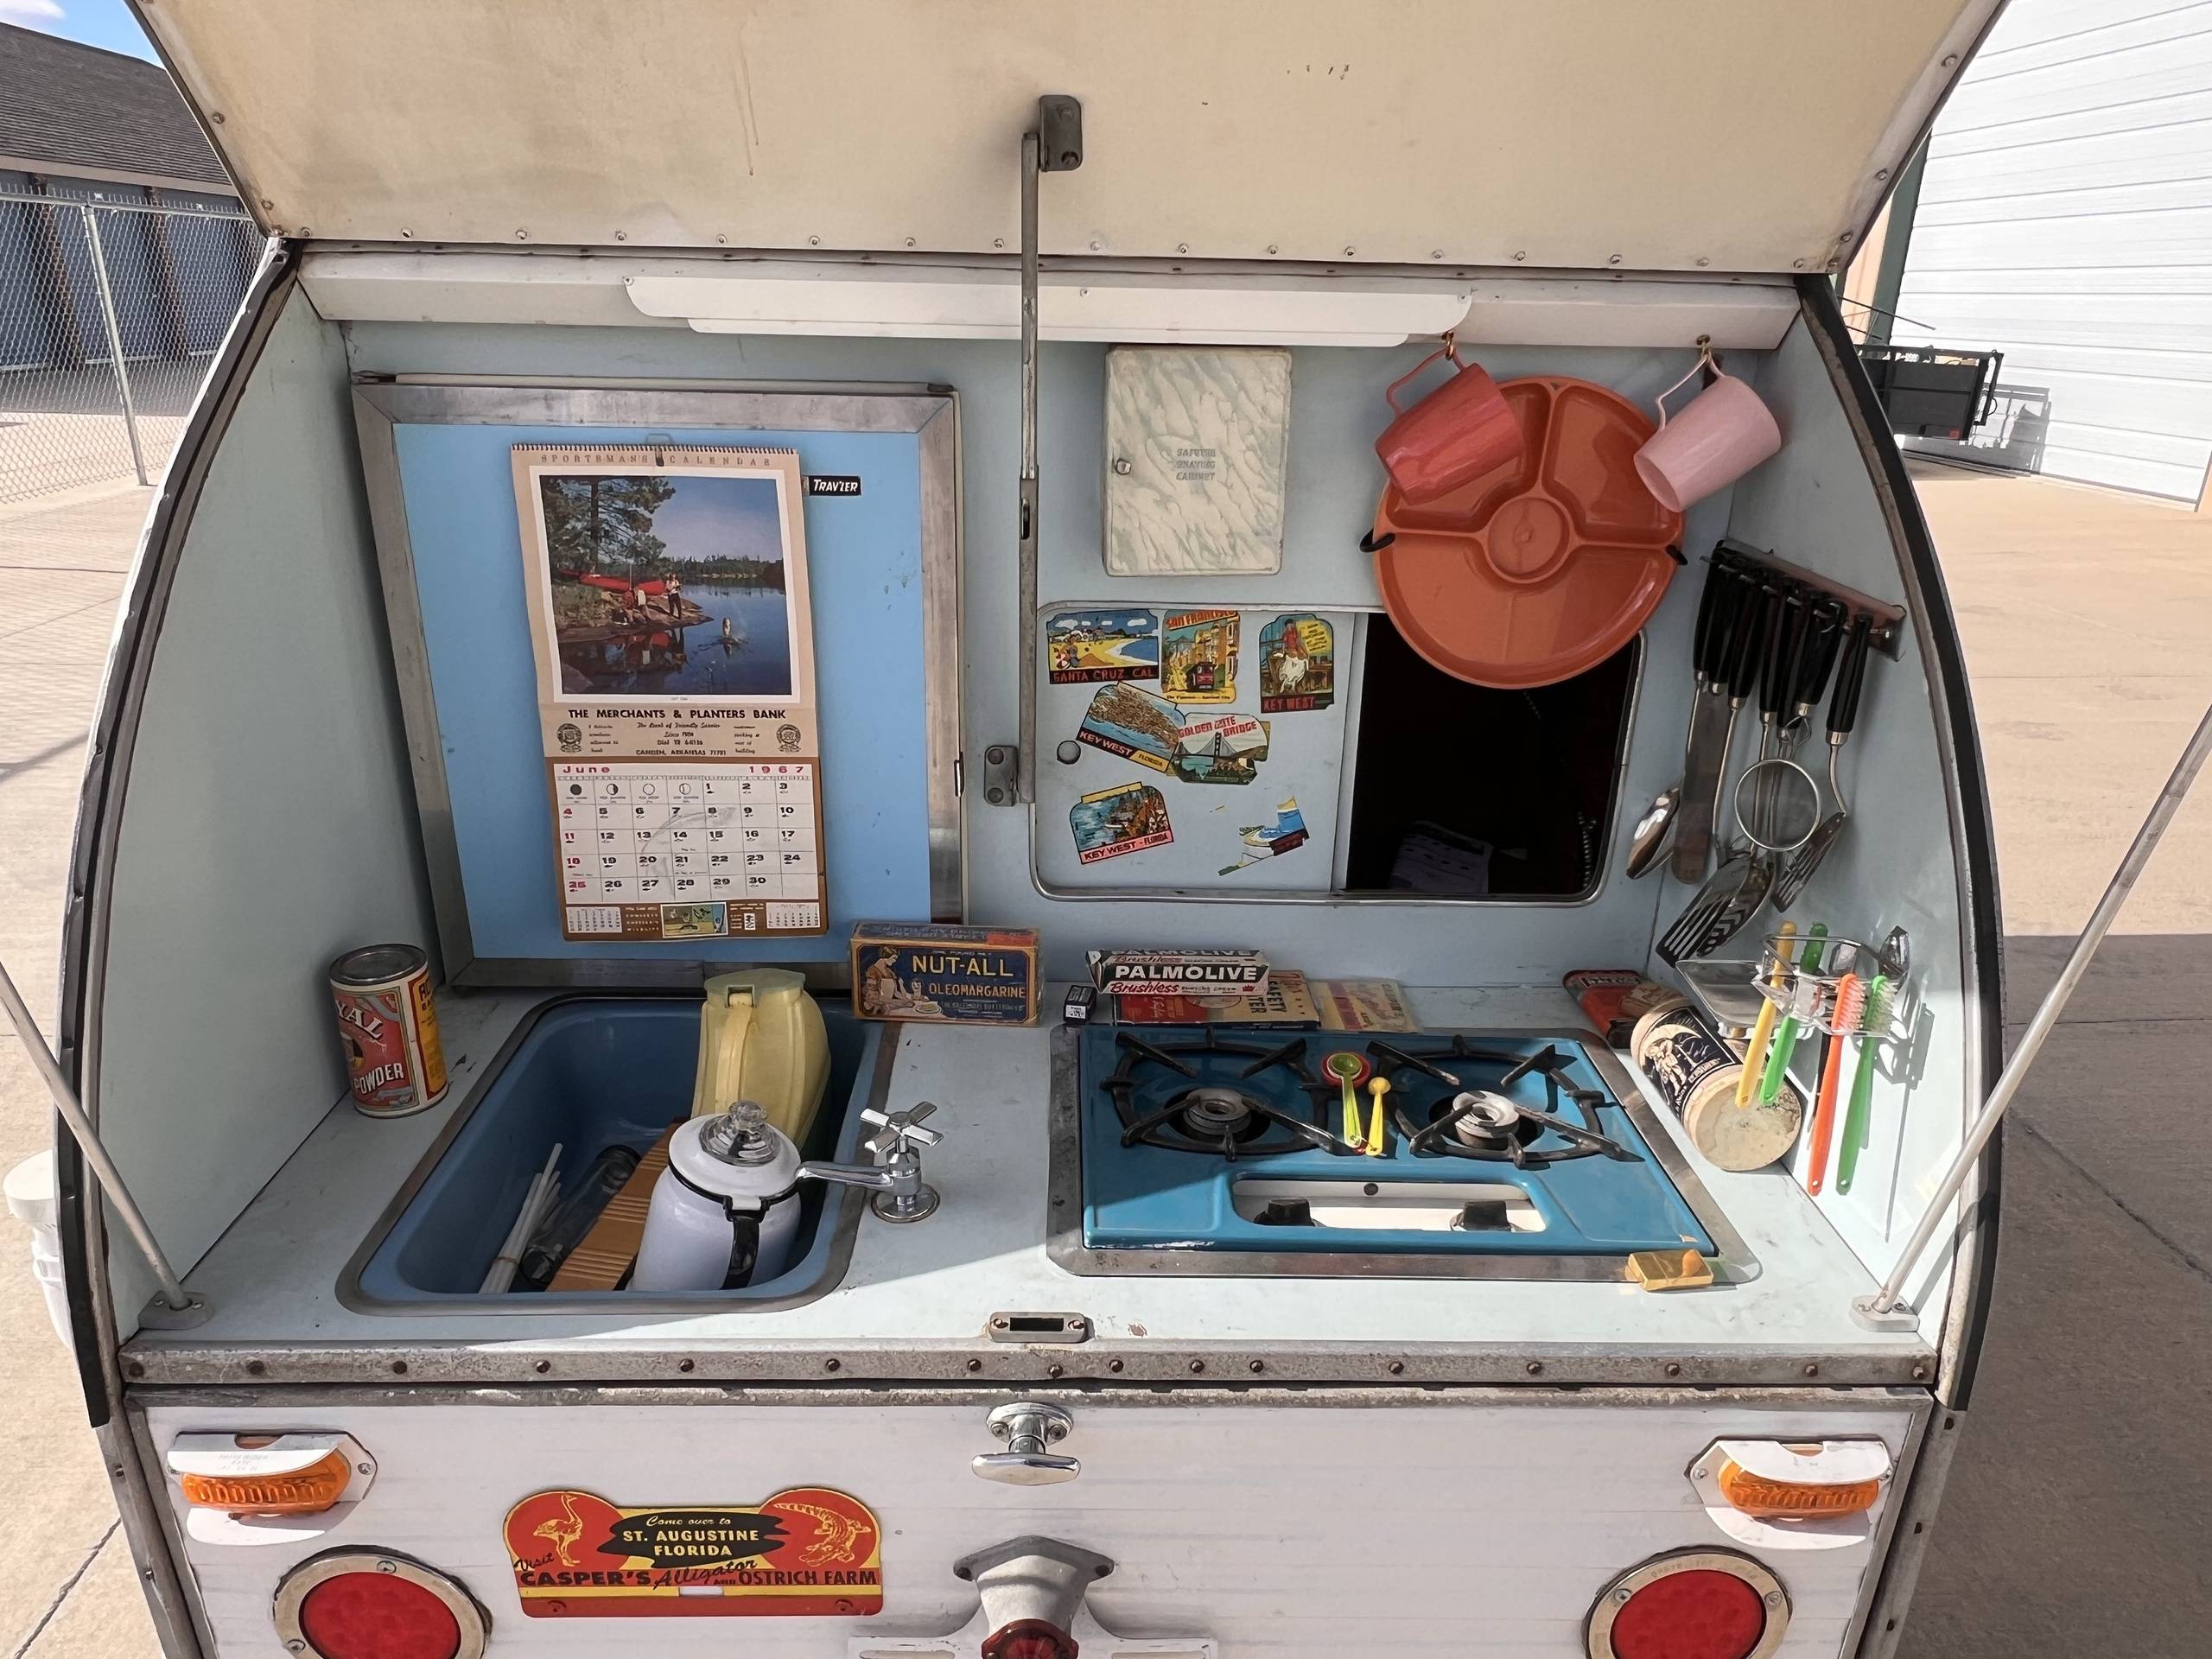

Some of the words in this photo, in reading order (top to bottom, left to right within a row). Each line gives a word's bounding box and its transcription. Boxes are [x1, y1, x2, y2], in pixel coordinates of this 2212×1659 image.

[670, 455, 770, 467] CALENDAR
[1053, 671, 1089, 683] SANTA
[1092, 669, 1124, 681] CRUZ
[1132, 667, 1154, 677] CAL
[1263, 698, 1283, 711] KEY
[1286, 696, 1314, 709] WEST
[569, 709, 589, 719] THE
[597, 709, 665, 719] MERCHANTS
[673, 709, 682, 719] &
[690, 709, 746, 719] PLANTERS
[753, 709, 785, 719] BANK
[1178, 721, 1213, 738] GOLDEN
[1223, 721, 1257, 737] BRIDGE
[1079, 731, 1102, 744] KEY
[1103, 740, 1133, 755] WEST
[1084, 849, 1106, 861] KEY
[1107, 841, 1137, 855] WEST
[1143, 833, 1168, 846] FLORIDA
[912, 955, 1014, 977] NUT-ALL
[1115, 964, 1257, 980] PALMOLIVE
[929, 982, 1027, 999] OLEOMARGARINE
[1110, 982, 1180, 994] Brushless
[334, 1000, 384, 1039] YAL
[353, 1062, 404, 1095] POWDER
[646, 1516, 683, 1527] Come
[719, 1517, 732, 1526] to
[623, 1530, 648, 1542] ST.
[656, 1529, 760, 1541] AUGUSTINE
[654, 1545, 733, 1556] FLORIDA
[513, 1552, 555, 1572] Visit
[520, 1571, 652, 1586] CASPER'S
[653, 1560, 758, 1590] Alligator
[739, 1570, 817, 1586] OSTRICH
[823, 1570, 877, 1586] FARM
